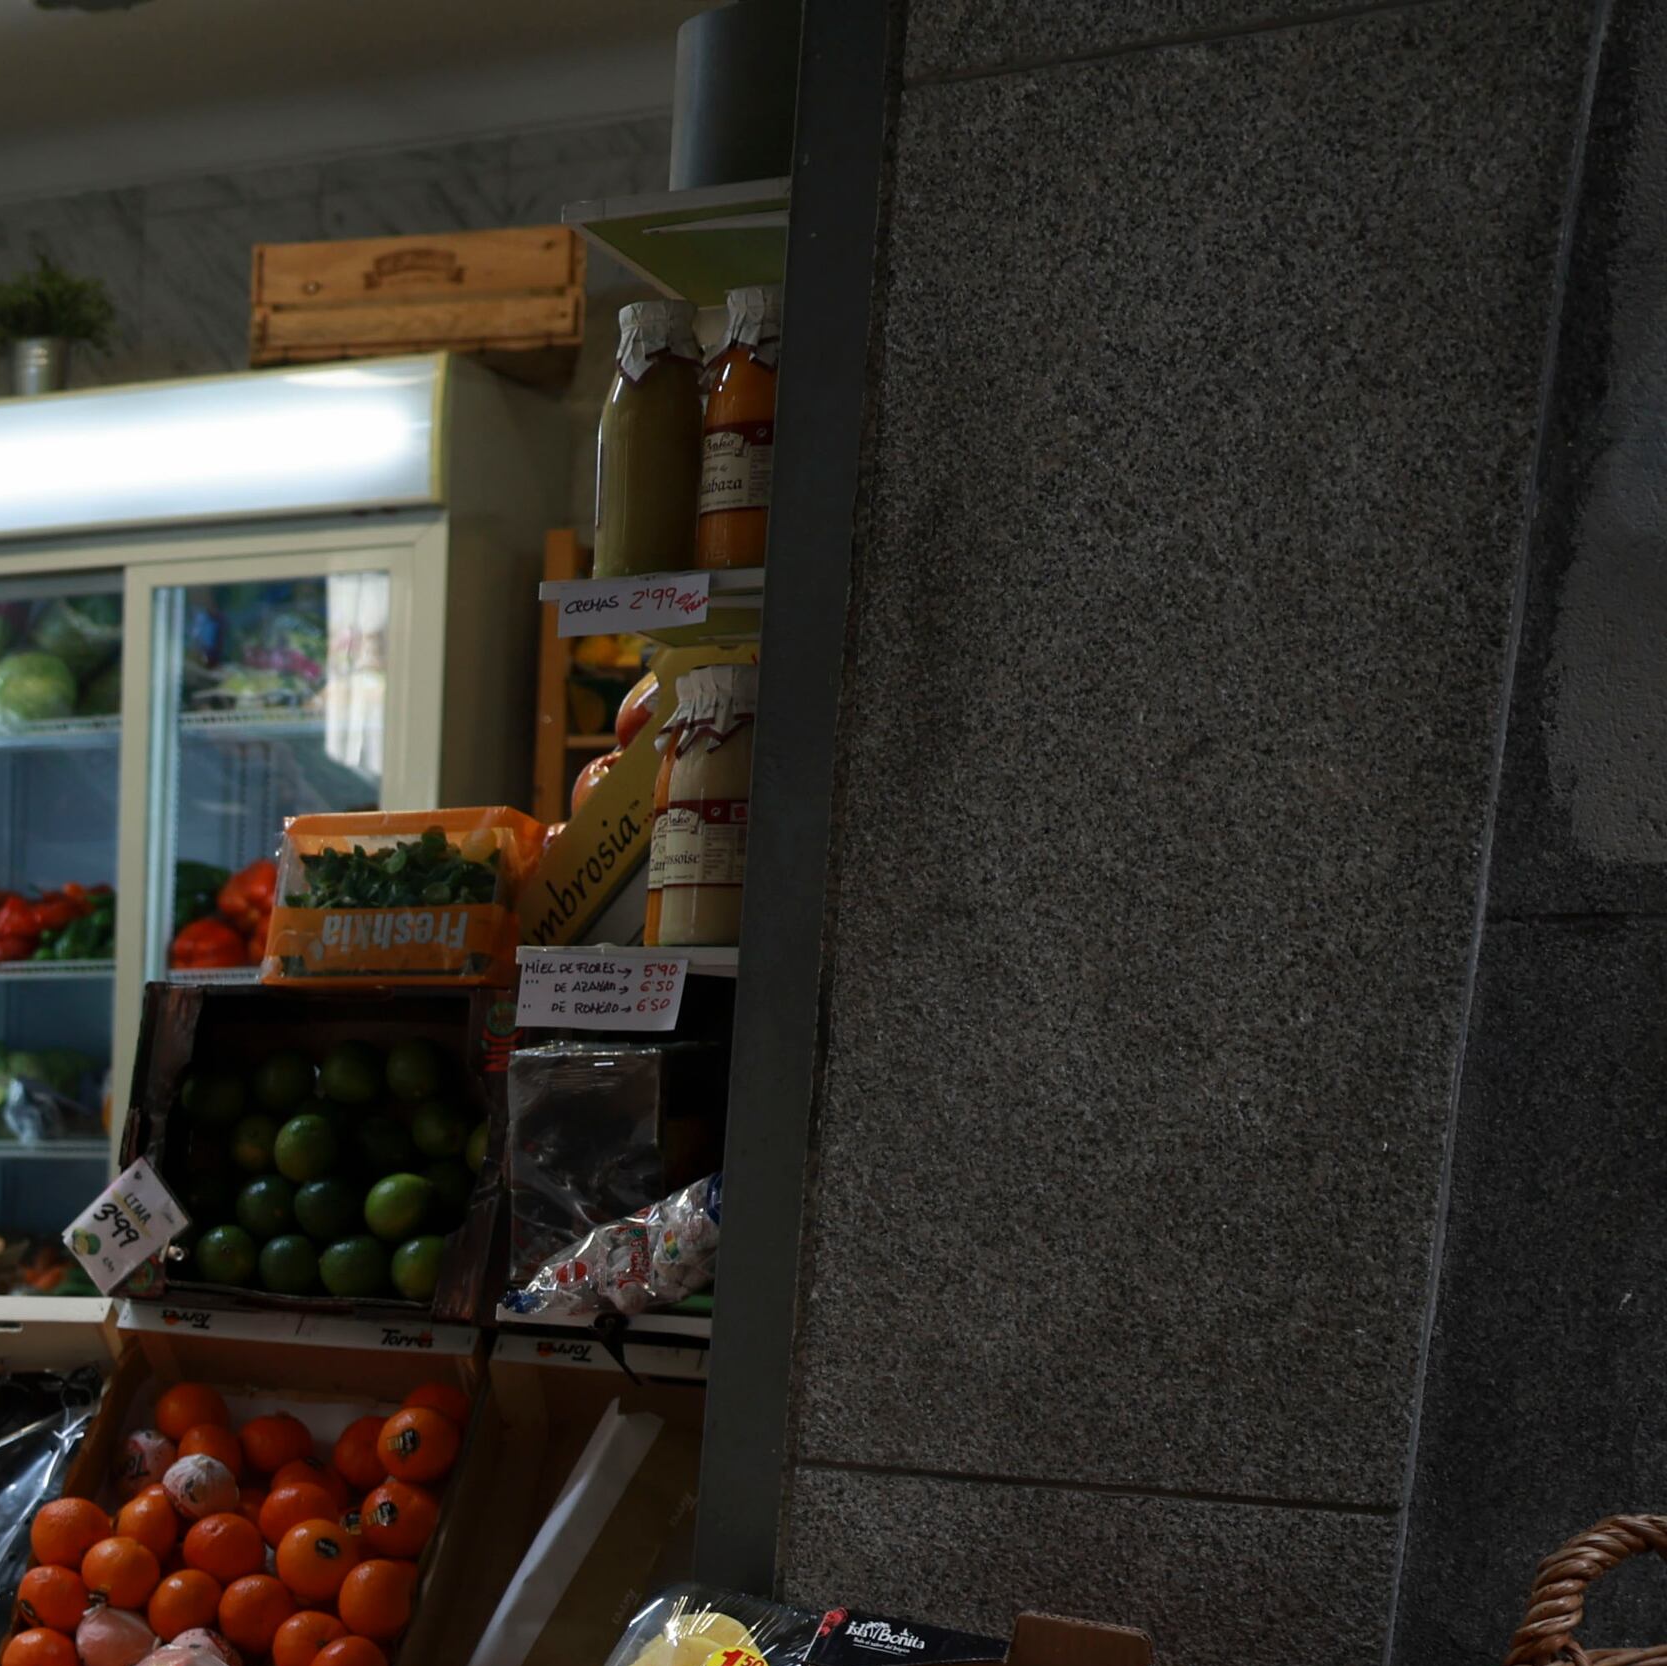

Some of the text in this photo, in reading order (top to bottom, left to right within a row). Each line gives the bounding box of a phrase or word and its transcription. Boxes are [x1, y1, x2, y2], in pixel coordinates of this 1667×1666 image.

[528, 814, 641, 948] mbrosia
[321, 910, 468, 950] Freshkia
[524, 959, 556, 975] MIEL
[553, 983, 567, 993] DE
[381, 1326, 435, 1349] Torres
[878, 1627, 926, 1650] Bonita
